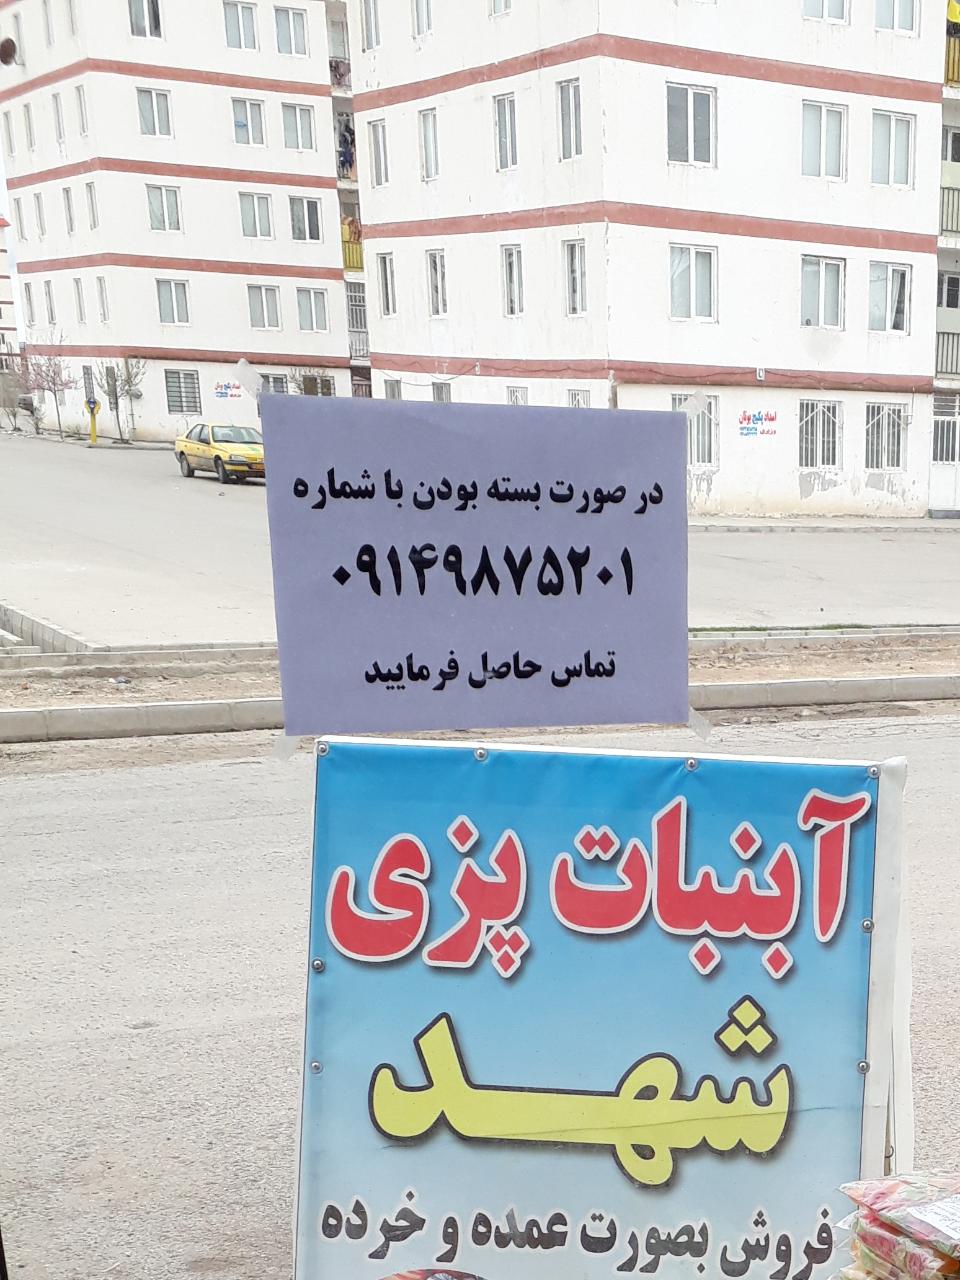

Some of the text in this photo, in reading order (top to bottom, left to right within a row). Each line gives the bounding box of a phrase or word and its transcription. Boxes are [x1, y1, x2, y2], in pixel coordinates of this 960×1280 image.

[293, 467, 664, 514] در صورت بسته بودن با شماره
[332, 543, 634, 597] ۰۹۱۴۹۸۷۵۲۰۱
[364, 649, 616, 691] تماس حاصل فرمایید
[326, 789, 871, 979] آبنبات پزی
[368, 994, 794, 1187] شهد
[320, 1191, 427, 1260] خرده
[441, 1213, 459, 1263] و
[471, 1208, 569, 1250] عمده
[580, 1210, 710, 1276] بصورت
[720, 1206, 836, 1280] فروش
